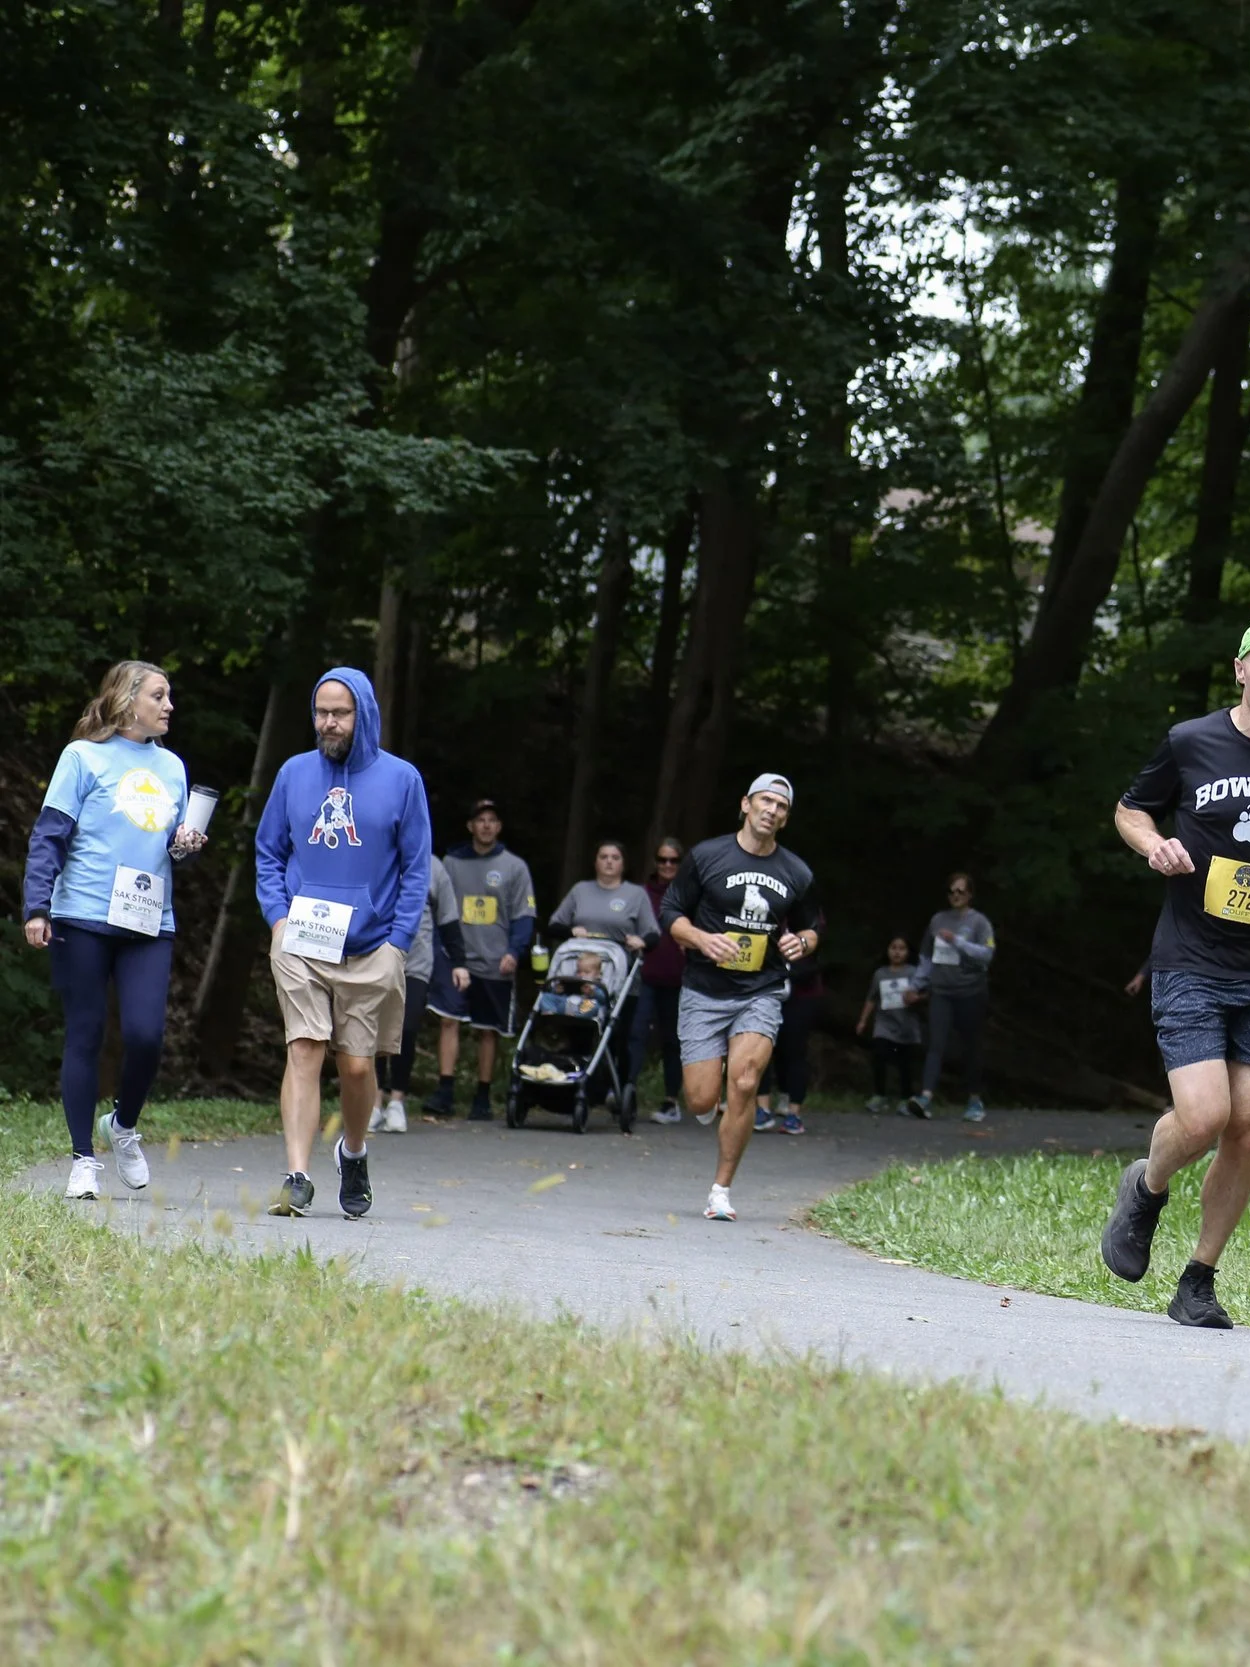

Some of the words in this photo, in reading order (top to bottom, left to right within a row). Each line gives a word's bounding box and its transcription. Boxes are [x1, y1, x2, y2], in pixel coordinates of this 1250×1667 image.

[726, 872, 788, 899] BOWDOIN
[114, 889, 131, 900] SAK
[131, 894, 163, 910] STRONG
[288, 918, 306, 927] SAK
[308, 921, 346, 937] STRONG
